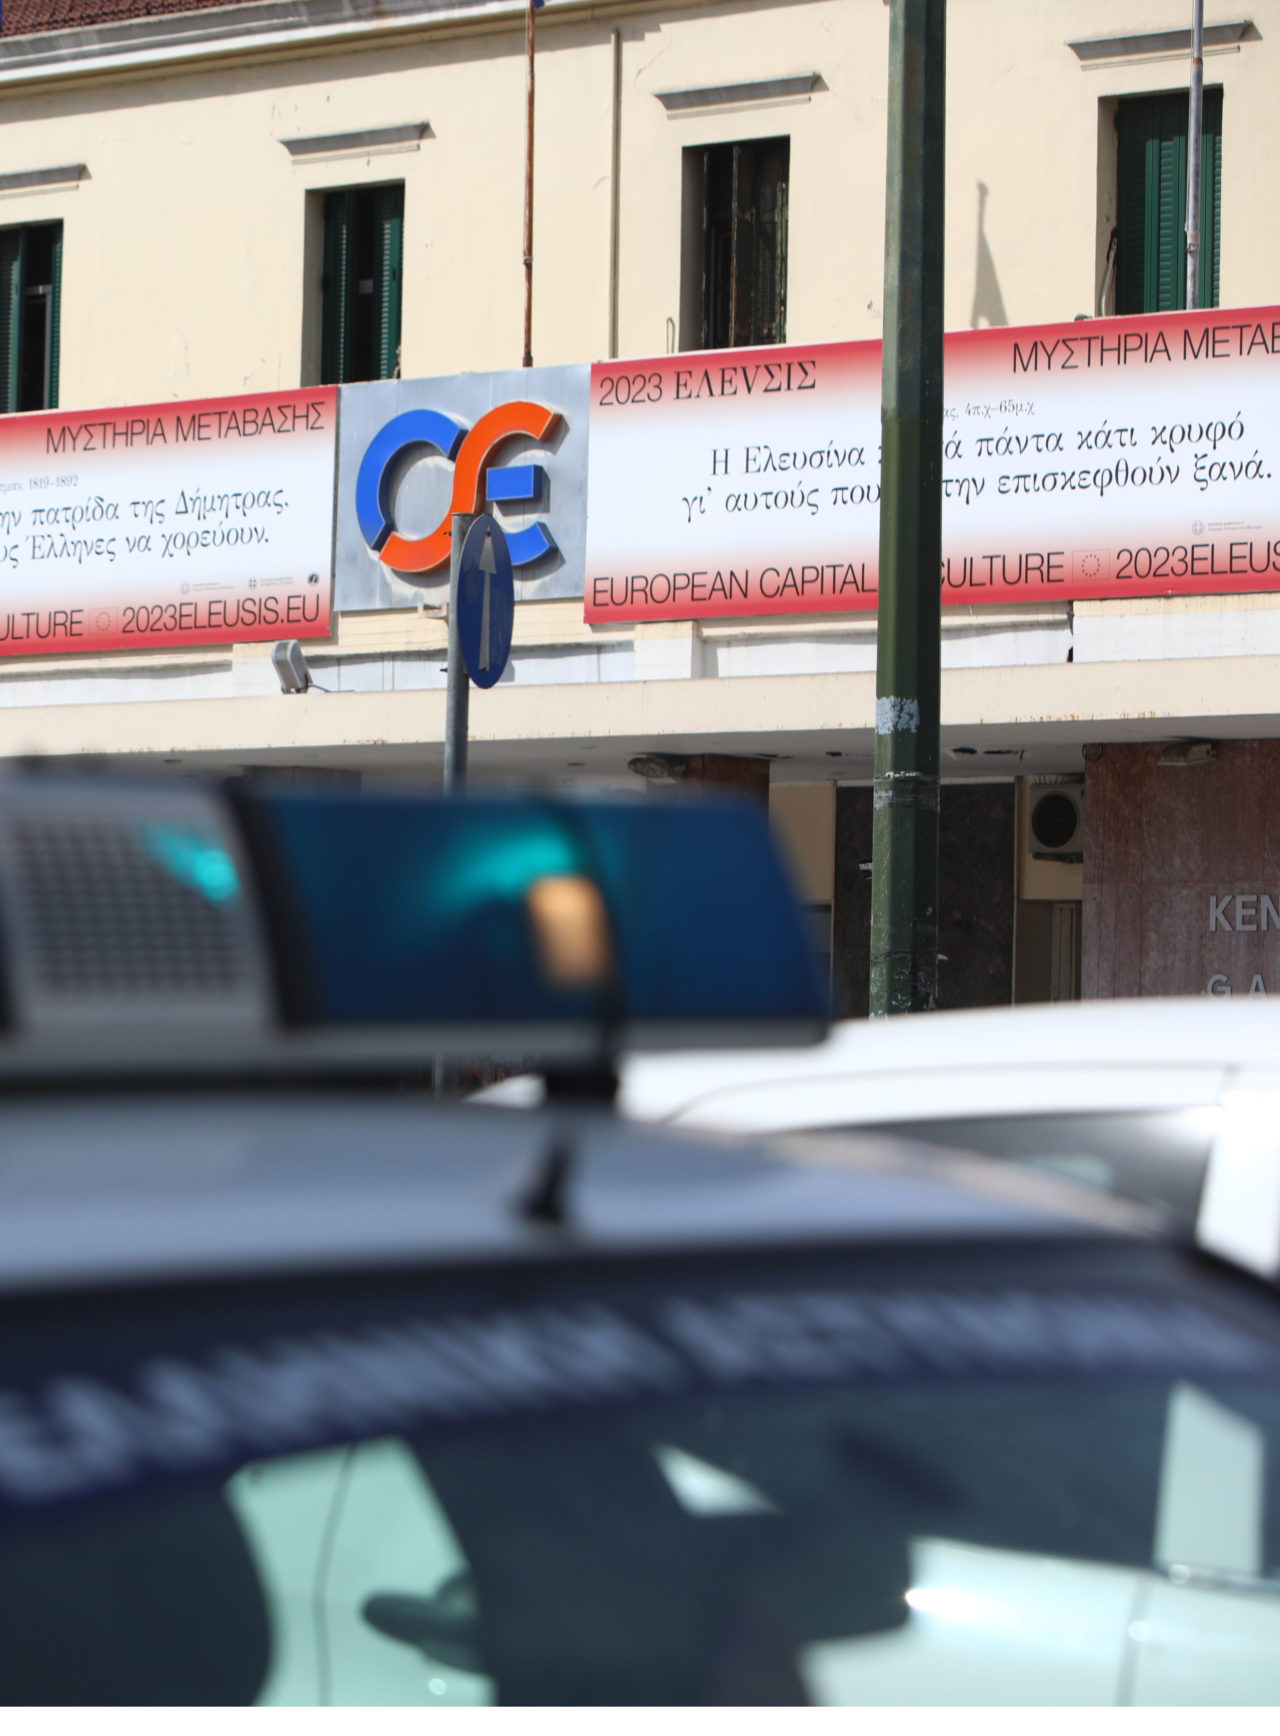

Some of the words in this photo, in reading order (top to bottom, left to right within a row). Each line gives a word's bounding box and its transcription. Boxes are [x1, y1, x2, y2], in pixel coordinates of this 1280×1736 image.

[1013, 330, 1171, 374] ΜΥΣΤΗΡΙΑ
[599, 372, 663, 406] 2023
[46, 416, 167, 454] ΜΥΣΤΗΡΙΑ
[175, 401, 326, 443] ΜΕΤΑΒΑΣΗΣ
[975, 426, 1064, 457] πάντα
[1076, 420, 1138, 451] κάτι
[1150, 410, 1246, 453] κρυφό
[711, 447, 731, 476] Η
[743, 439, 865, 475] Ελευσίνα
[942, 476, 986, 505] την
[997, 456, 1181, 497] επισκεφθούν
[1193, 449, 1273, 491] ξανά.
[31, 495, 120, 530] πατρίδα
[130, 498, 166, 524] της
[725, 480, 820, 516] αυτούς
[831, 482, 882, 506] που
[24, 532, 117, 564] Έλληνες
[125, 533, 152, 553] να
[161, 520, 270, 558] χορεύουν.
[593, 569, 749, 608] EUROPEAN
[759, 562, 878, 599] CAPITAL
[121, 593, 320, 635] 2023ELEUSIS.EU
